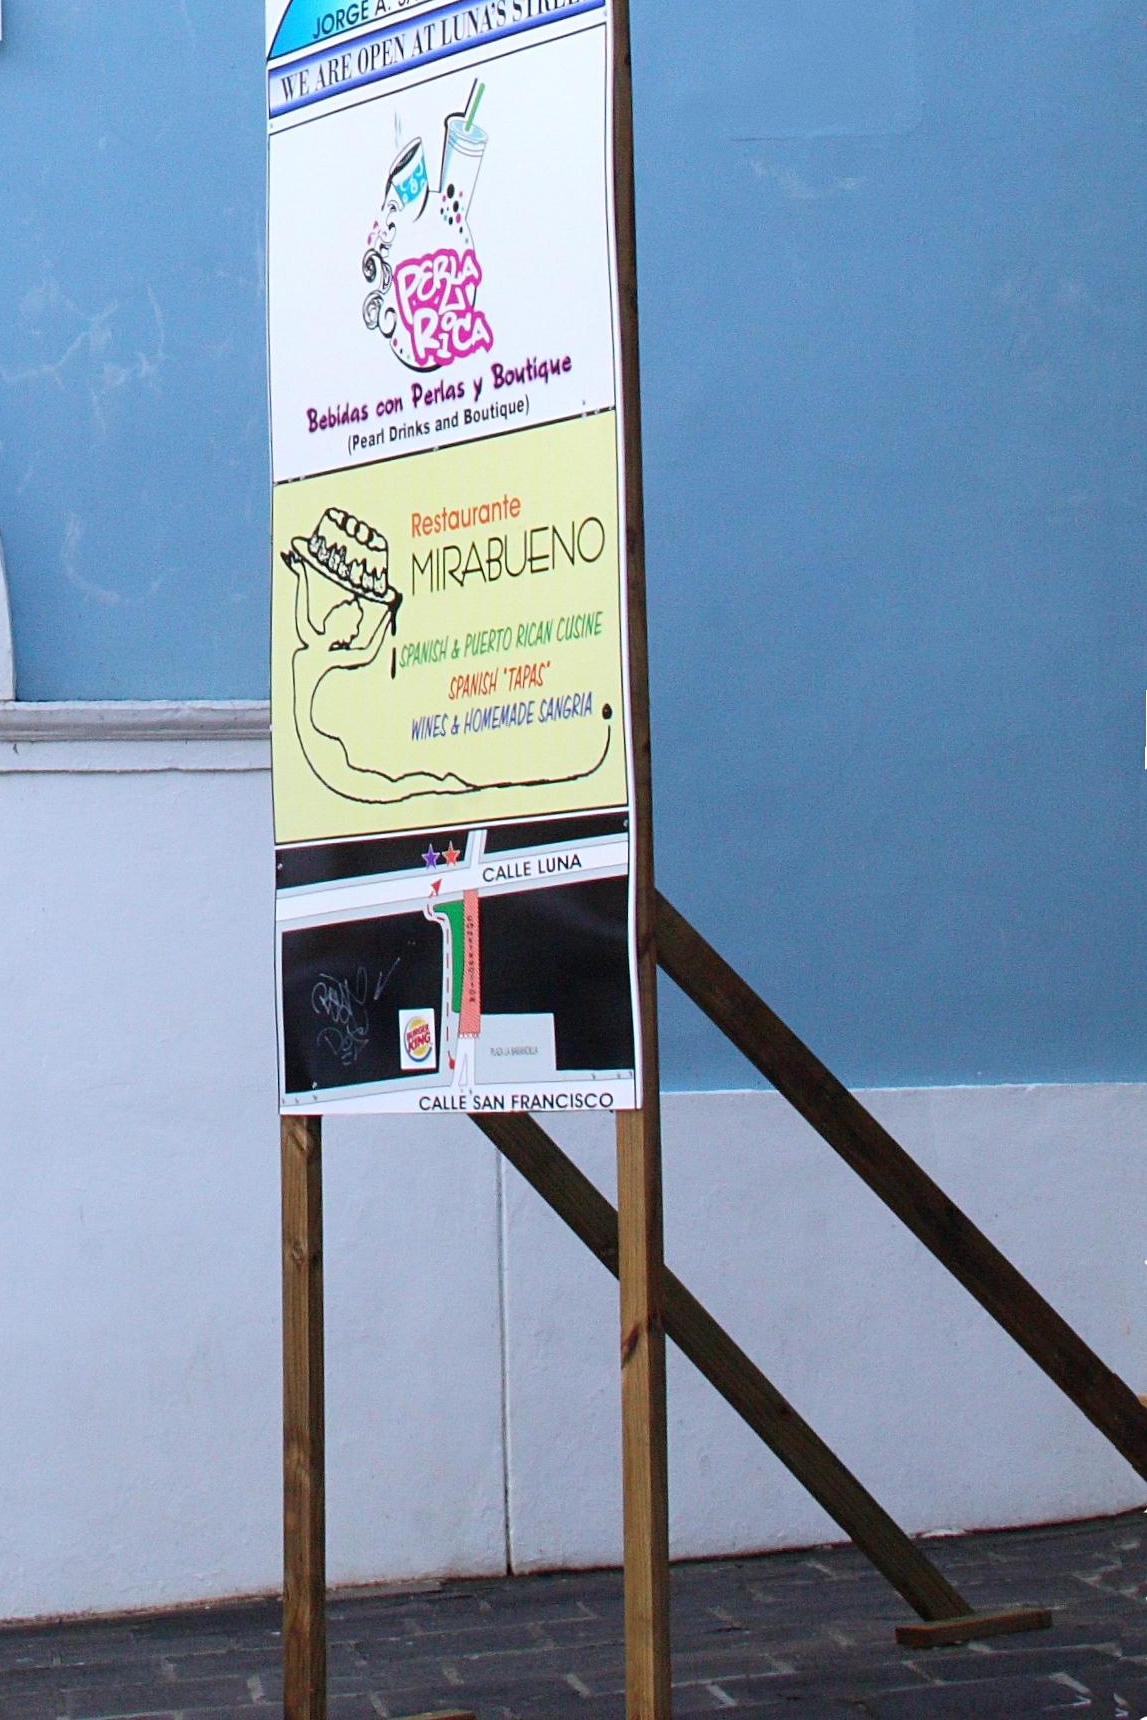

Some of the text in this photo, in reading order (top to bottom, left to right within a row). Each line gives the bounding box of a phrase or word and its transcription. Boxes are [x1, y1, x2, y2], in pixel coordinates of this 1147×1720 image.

[312, 0, 369, 40] JORGE
[281, 71, 310, 101] WE
[315, 52, 352, 91] ARE
[357, 40, 406, 76] OPEN
[410, 22, 437, 58] AT
[307, 355, 573, 433] Bebidas con Perlas y Boutique
[347, 394, 530, 455] (Pearl Drinks and Boutique)
[411, 493, 522, 538] Restaurante
[411, 516, 606, 596] MIRABUENO
[399, 610, 604, 668] SPANISH & PUERTO RICAN CUSINE
[448, 667, 499, 700] SPANISH
[411, 690, 593, 742] WINES & HOMEMADE SANGRIA
[482, 853, 583, 883] CALLE LUNA
[406, 1023, 430, 1040] BURGER
[408, 1031, 431, 1053] KING
[418, 1091, 614, 1111] CALLE SAN FRANCISCO
